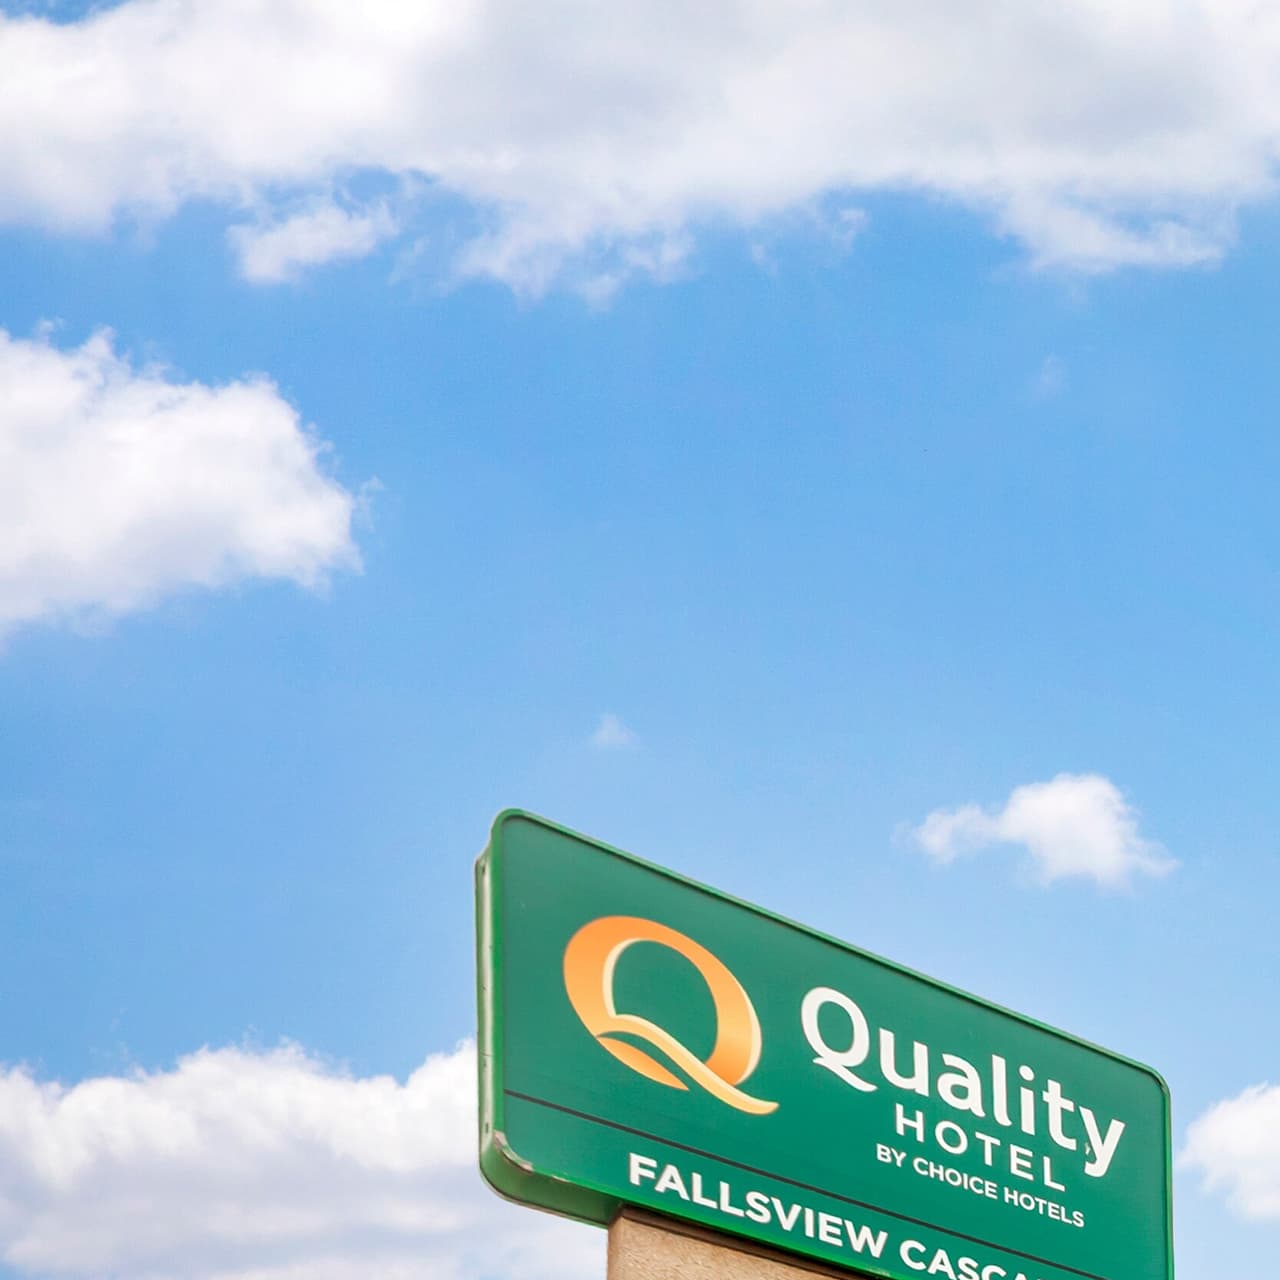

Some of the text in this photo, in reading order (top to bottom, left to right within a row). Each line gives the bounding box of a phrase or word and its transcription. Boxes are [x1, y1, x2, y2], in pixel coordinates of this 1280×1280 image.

[801, 987, 1126, 1177] Quality
[877, 1143, 1085, 1228] BY CHOICE HOTELS
[896, 1104, 1066, 1192] HOTEL
[629, 1153, 889, 1258] FALLSVIEW
